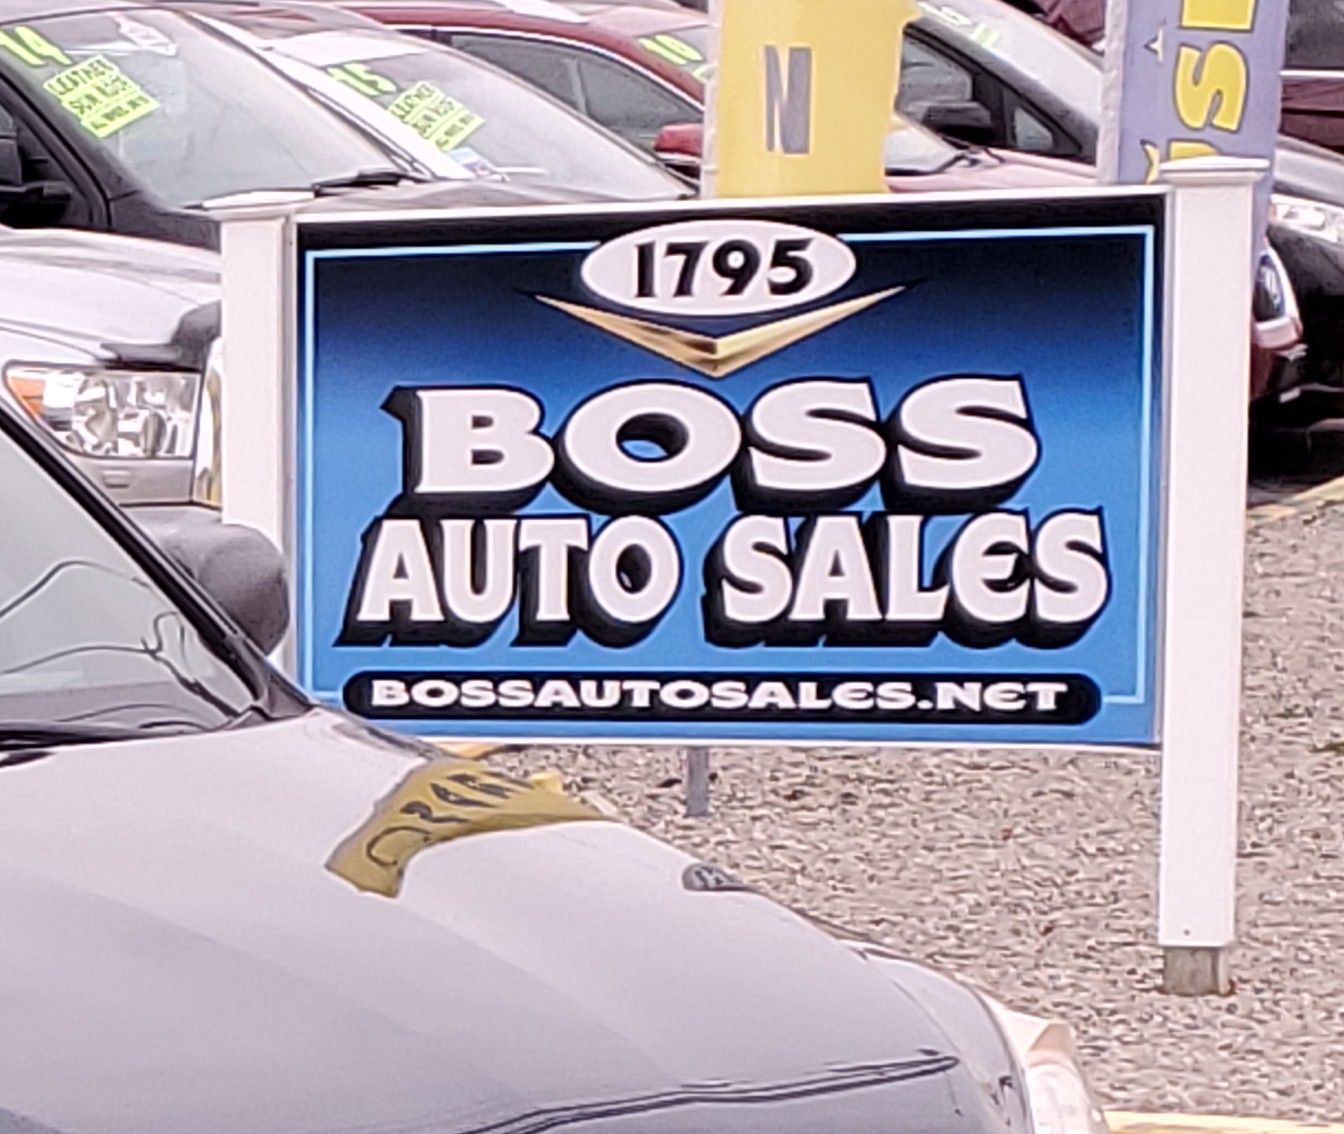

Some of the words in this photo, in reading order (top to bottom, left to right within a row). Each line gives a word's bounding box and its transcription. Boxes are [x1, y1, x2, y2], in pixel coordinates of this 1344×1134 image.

[634, 238, 814, 297] 1795
[404, 377, 1041, 500] BOSS
[352, 513, 683, 630] AUTO
[716, 510, 1111, 630] SALES
[368, 677, 1070, 715] BOSSAUTOSALES.NET
